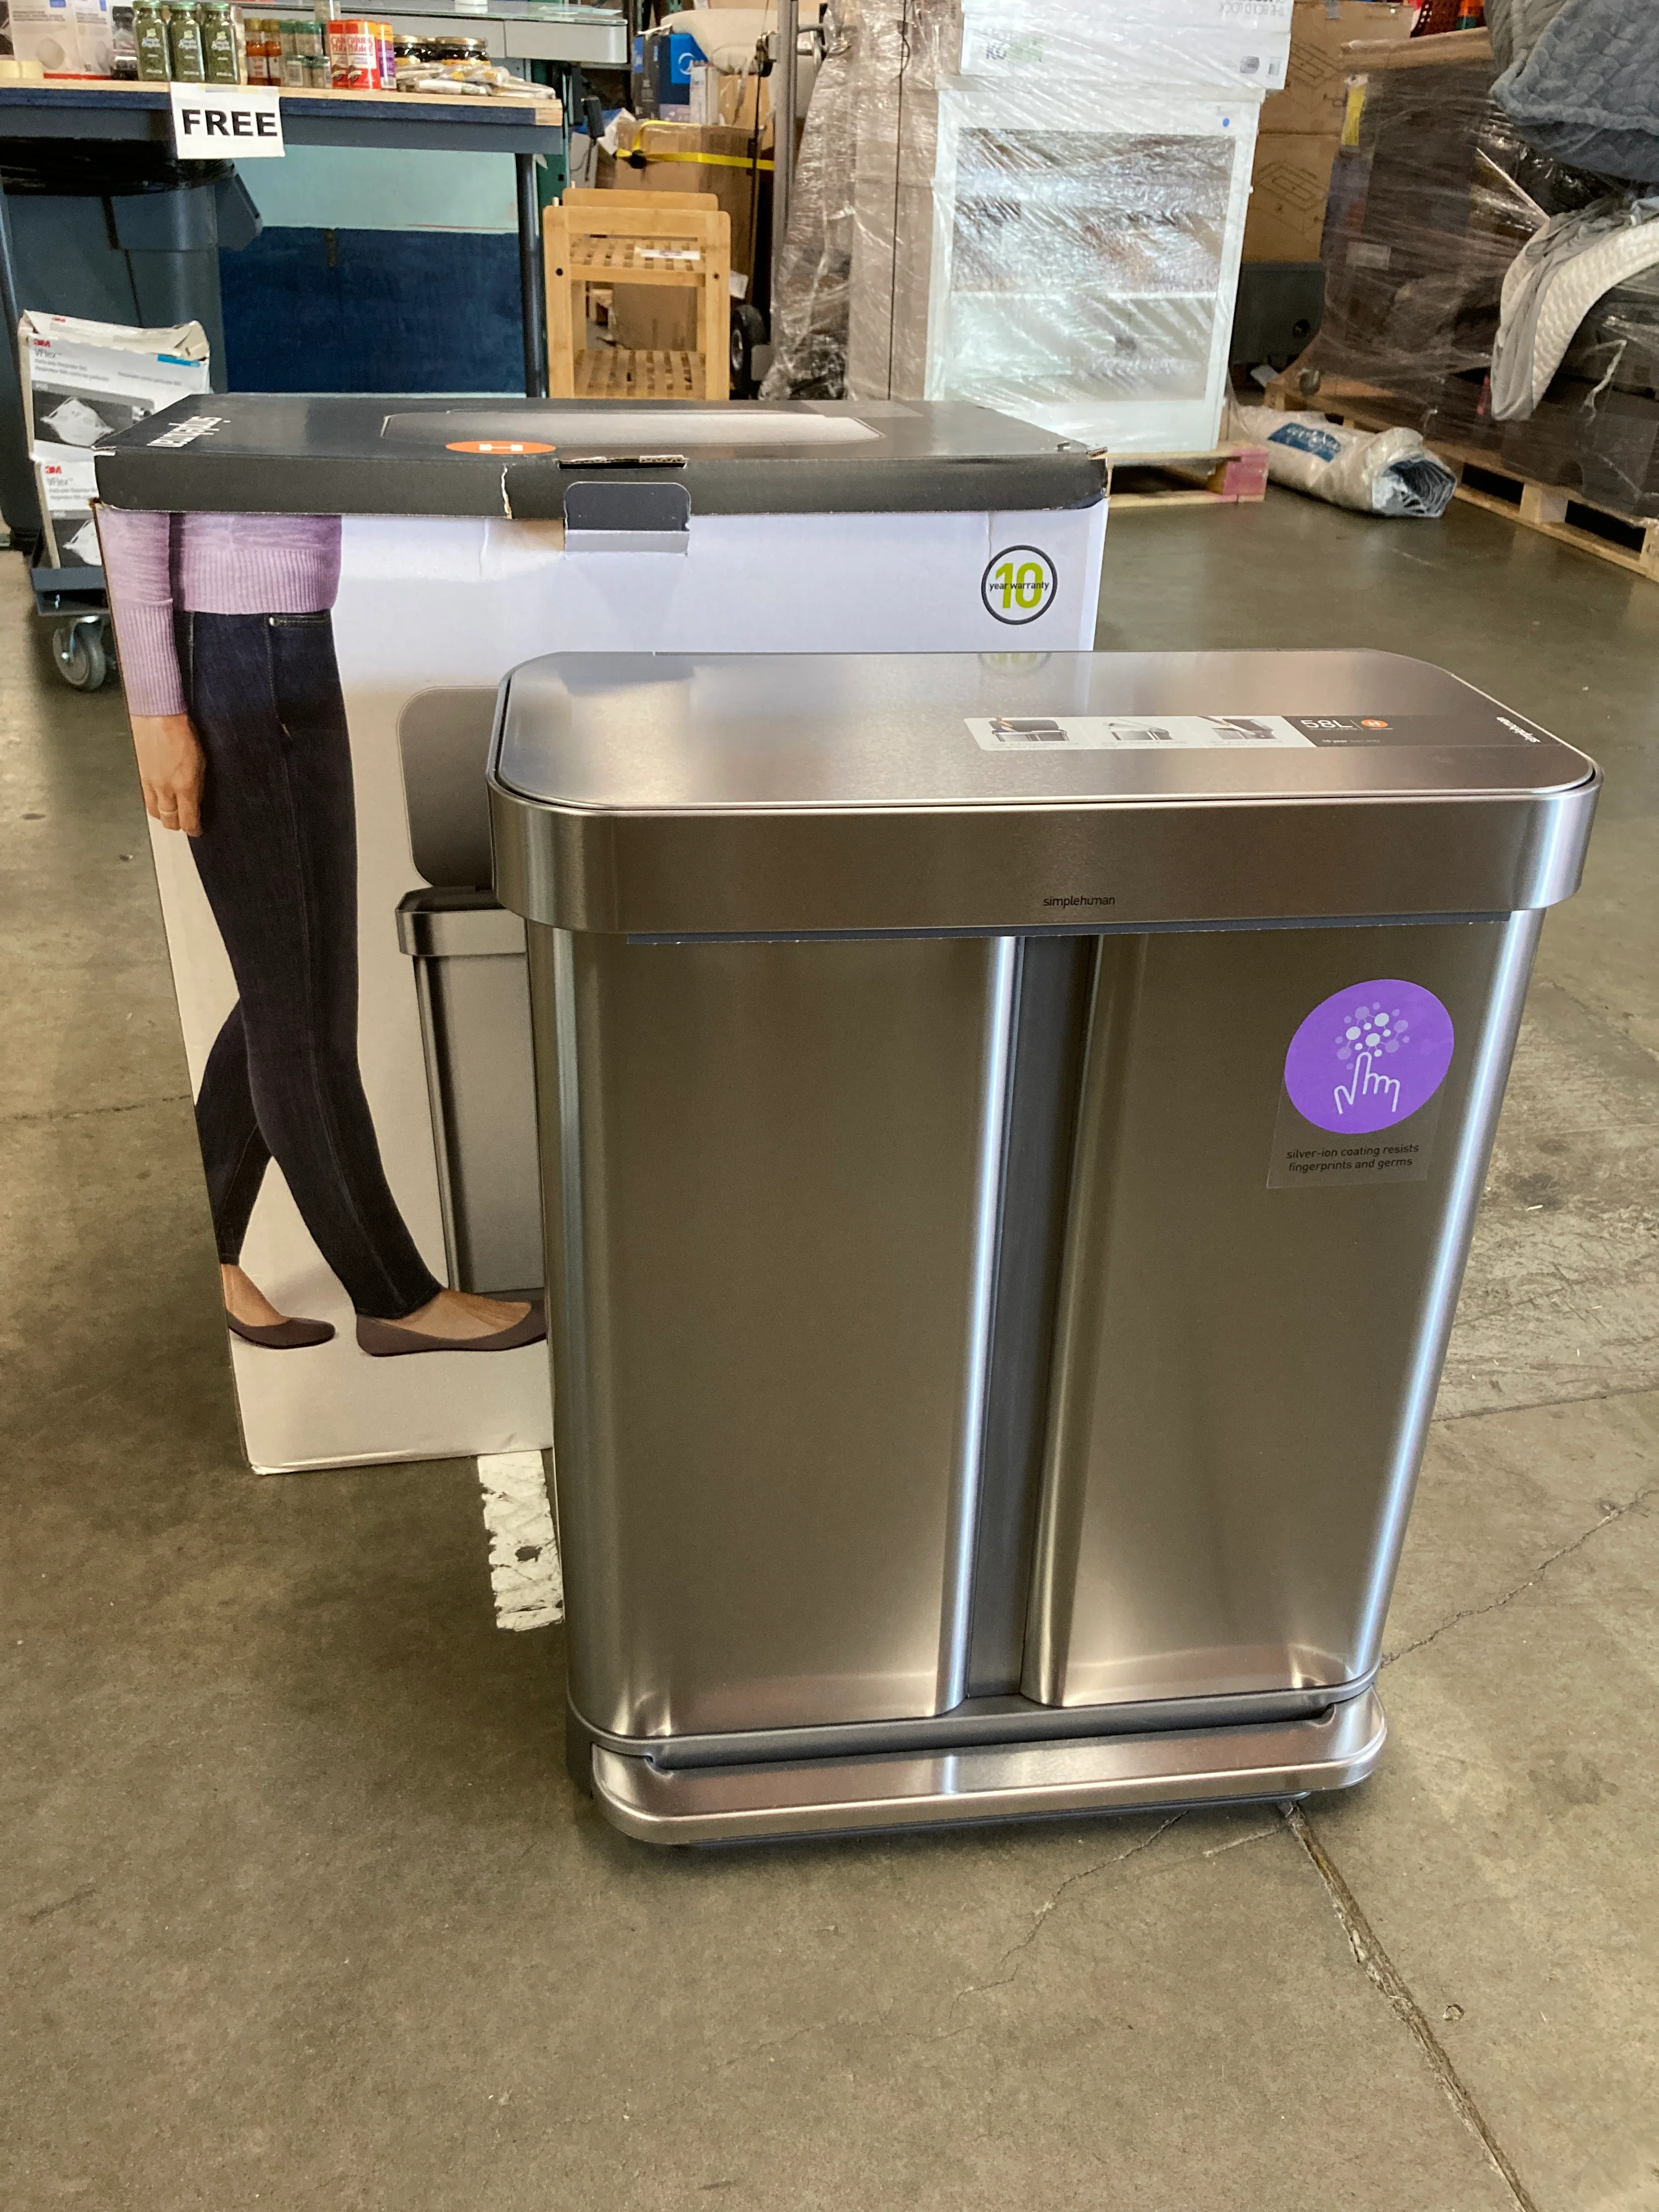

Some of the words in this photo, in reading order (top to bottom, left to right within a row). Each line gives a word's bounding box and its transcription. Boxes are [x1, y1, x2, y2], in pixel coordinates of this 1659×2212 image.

[182, 109, 278, 137] FREE
[33, 338, 51, 347] 3M
[45, 465, 62, 474] 3M
[989, 583, 1008, 591] year
[1010, 582, 1049, 591] warranty
[996, 562, 1043, 608] 10
[1300, 720, 1353, 728] 58L
[1043, 895, 1115, 909] simplehuman
[1286, 1147, 1338, 1159] silver-ion
[1341, 1146, 1380, 1157] coating
[1383, 1143, 1419, 1154] resists
[1289, 1161, 1352, 1173] fingerprints
[1355, 1159, 1375, 1169] and
[1378, 1158, 1413, 1170] germs
